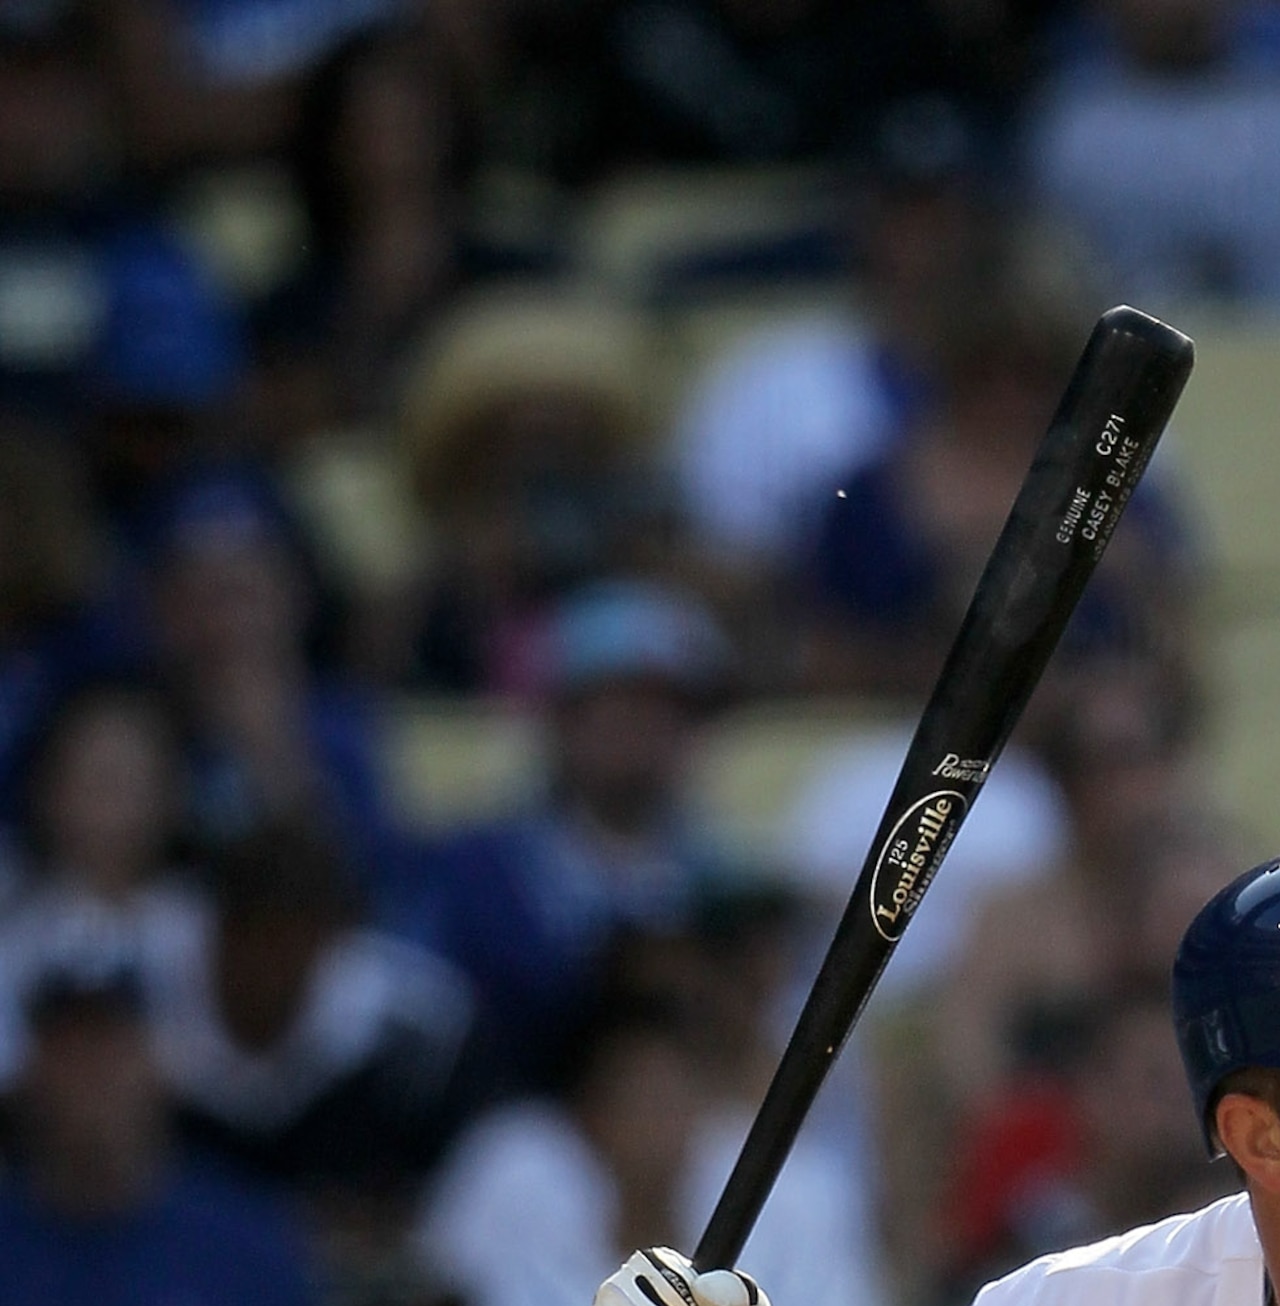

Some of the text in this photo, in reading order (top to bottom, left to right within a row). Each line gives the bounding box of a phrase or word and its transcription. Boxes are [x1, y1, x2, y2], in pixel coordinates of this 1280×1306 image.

[1056, 414, 1125, 544] GENUINE C271
[1082, 436, 1139, 541] CASEY BLAKE
[876, 798, 952, 923] Louisville
[888, 839, 908, 865] 125
